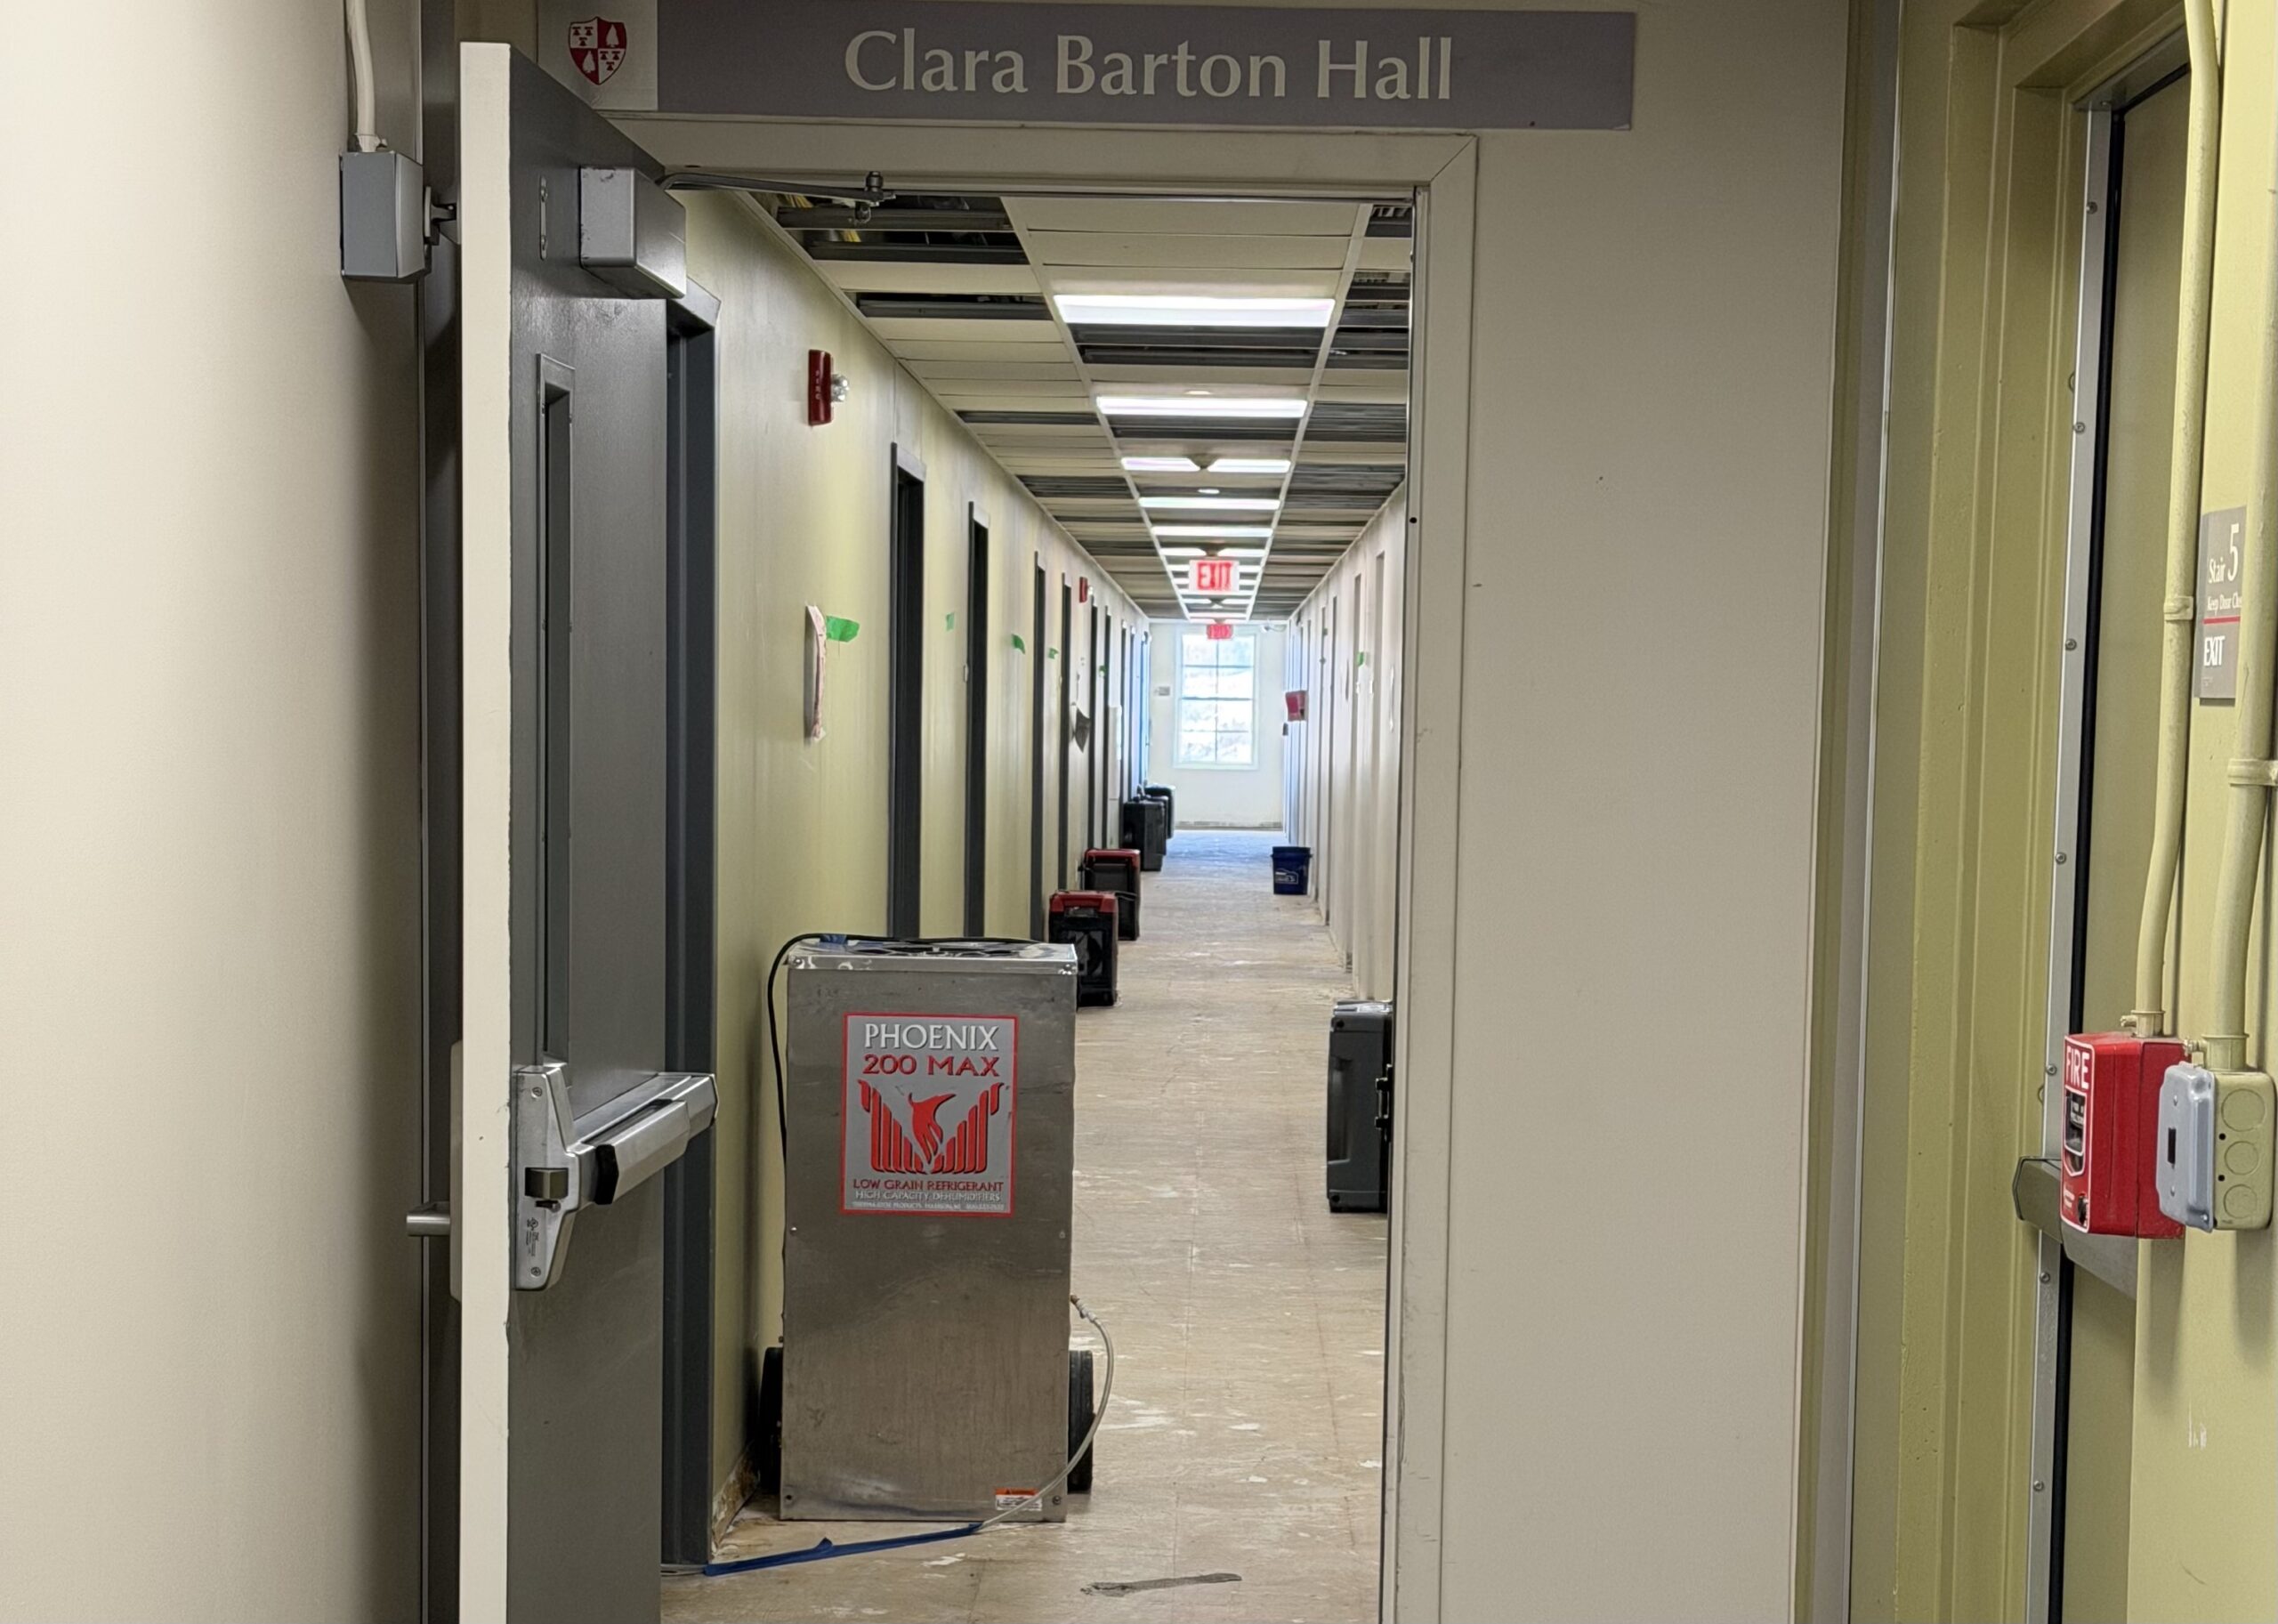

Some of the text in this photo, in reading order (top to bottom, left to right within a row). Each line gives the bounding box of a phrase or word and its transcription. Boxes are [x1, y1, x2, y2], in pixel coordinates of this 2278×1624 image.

[845, 28, 1451, 100] Clara Barton Hall
[2209, 522, 2240, 584] Stair 5
[1197, 562, 1232, 591] EXIT
[2203, 635, 2225, 667] EXIT
[864, 1023, 999, 1051] PHOENIX
[862, 1054, 1000, 1077] 200 MAX
[2065, 1045, 2089, 1090] FIRE
[852, 1179, 1004, 1192] LOW GRAIN REFRIGERANT
[855, 1191, 881, 1200] HIGH
[884, 1192, 931, 1200] CAPACITY
